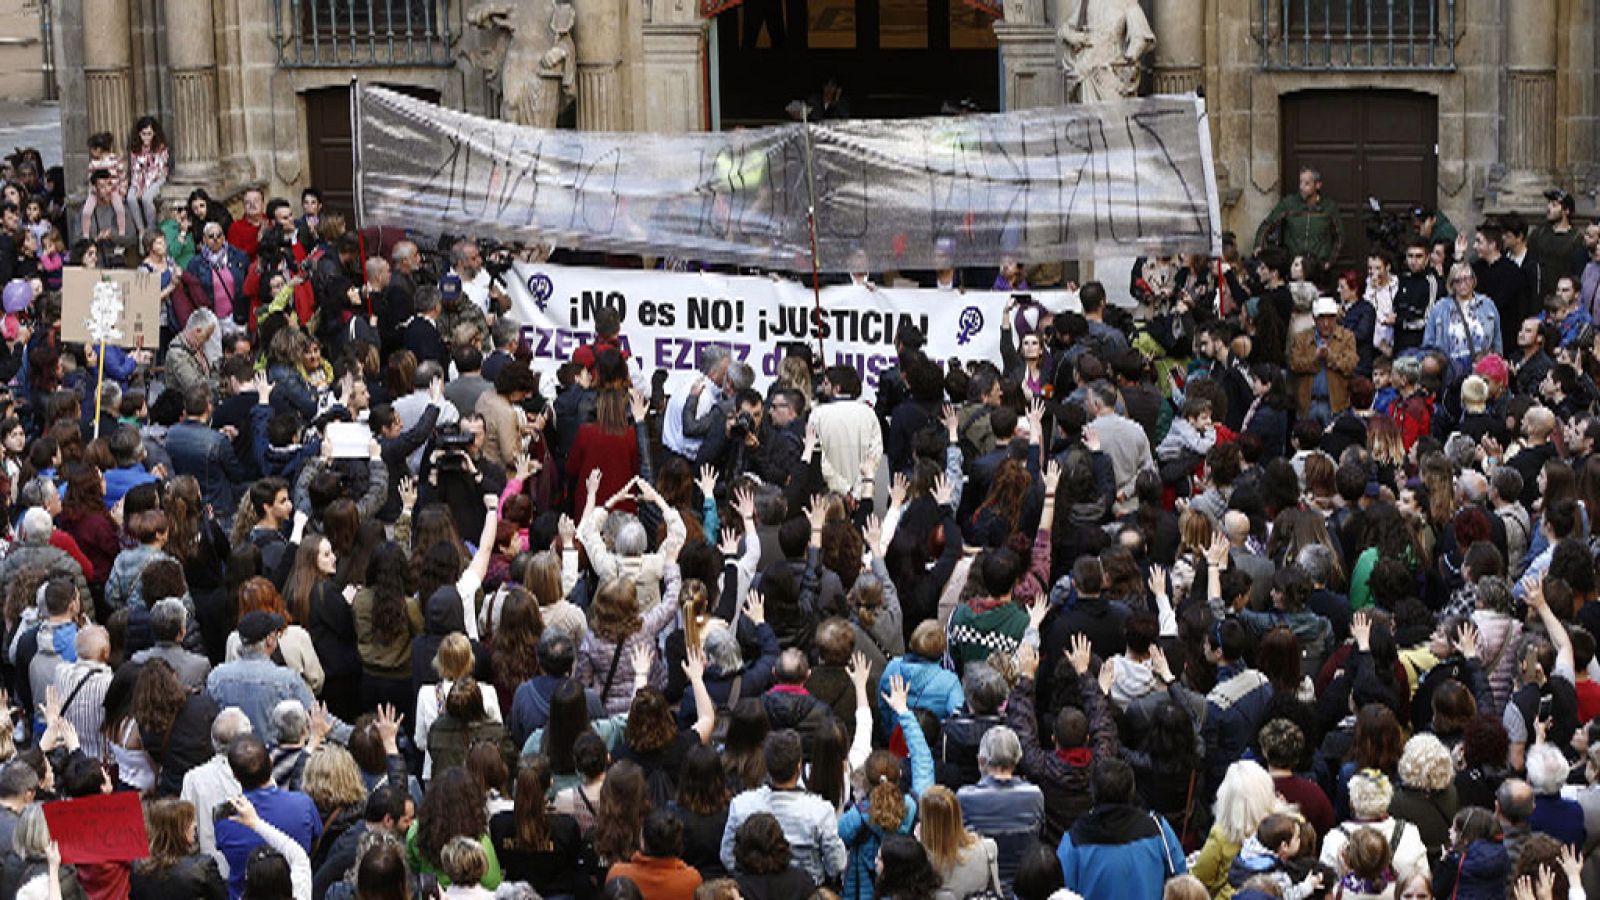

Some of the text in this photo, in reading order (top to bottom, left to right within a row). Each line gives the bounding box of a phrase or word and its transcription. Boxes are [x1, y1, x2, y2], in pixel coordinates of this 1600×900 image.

[569, 291, 626, 328] ¡NO
[638, 300, 676, 326] es
[687, 297, 745, 332] NO!
